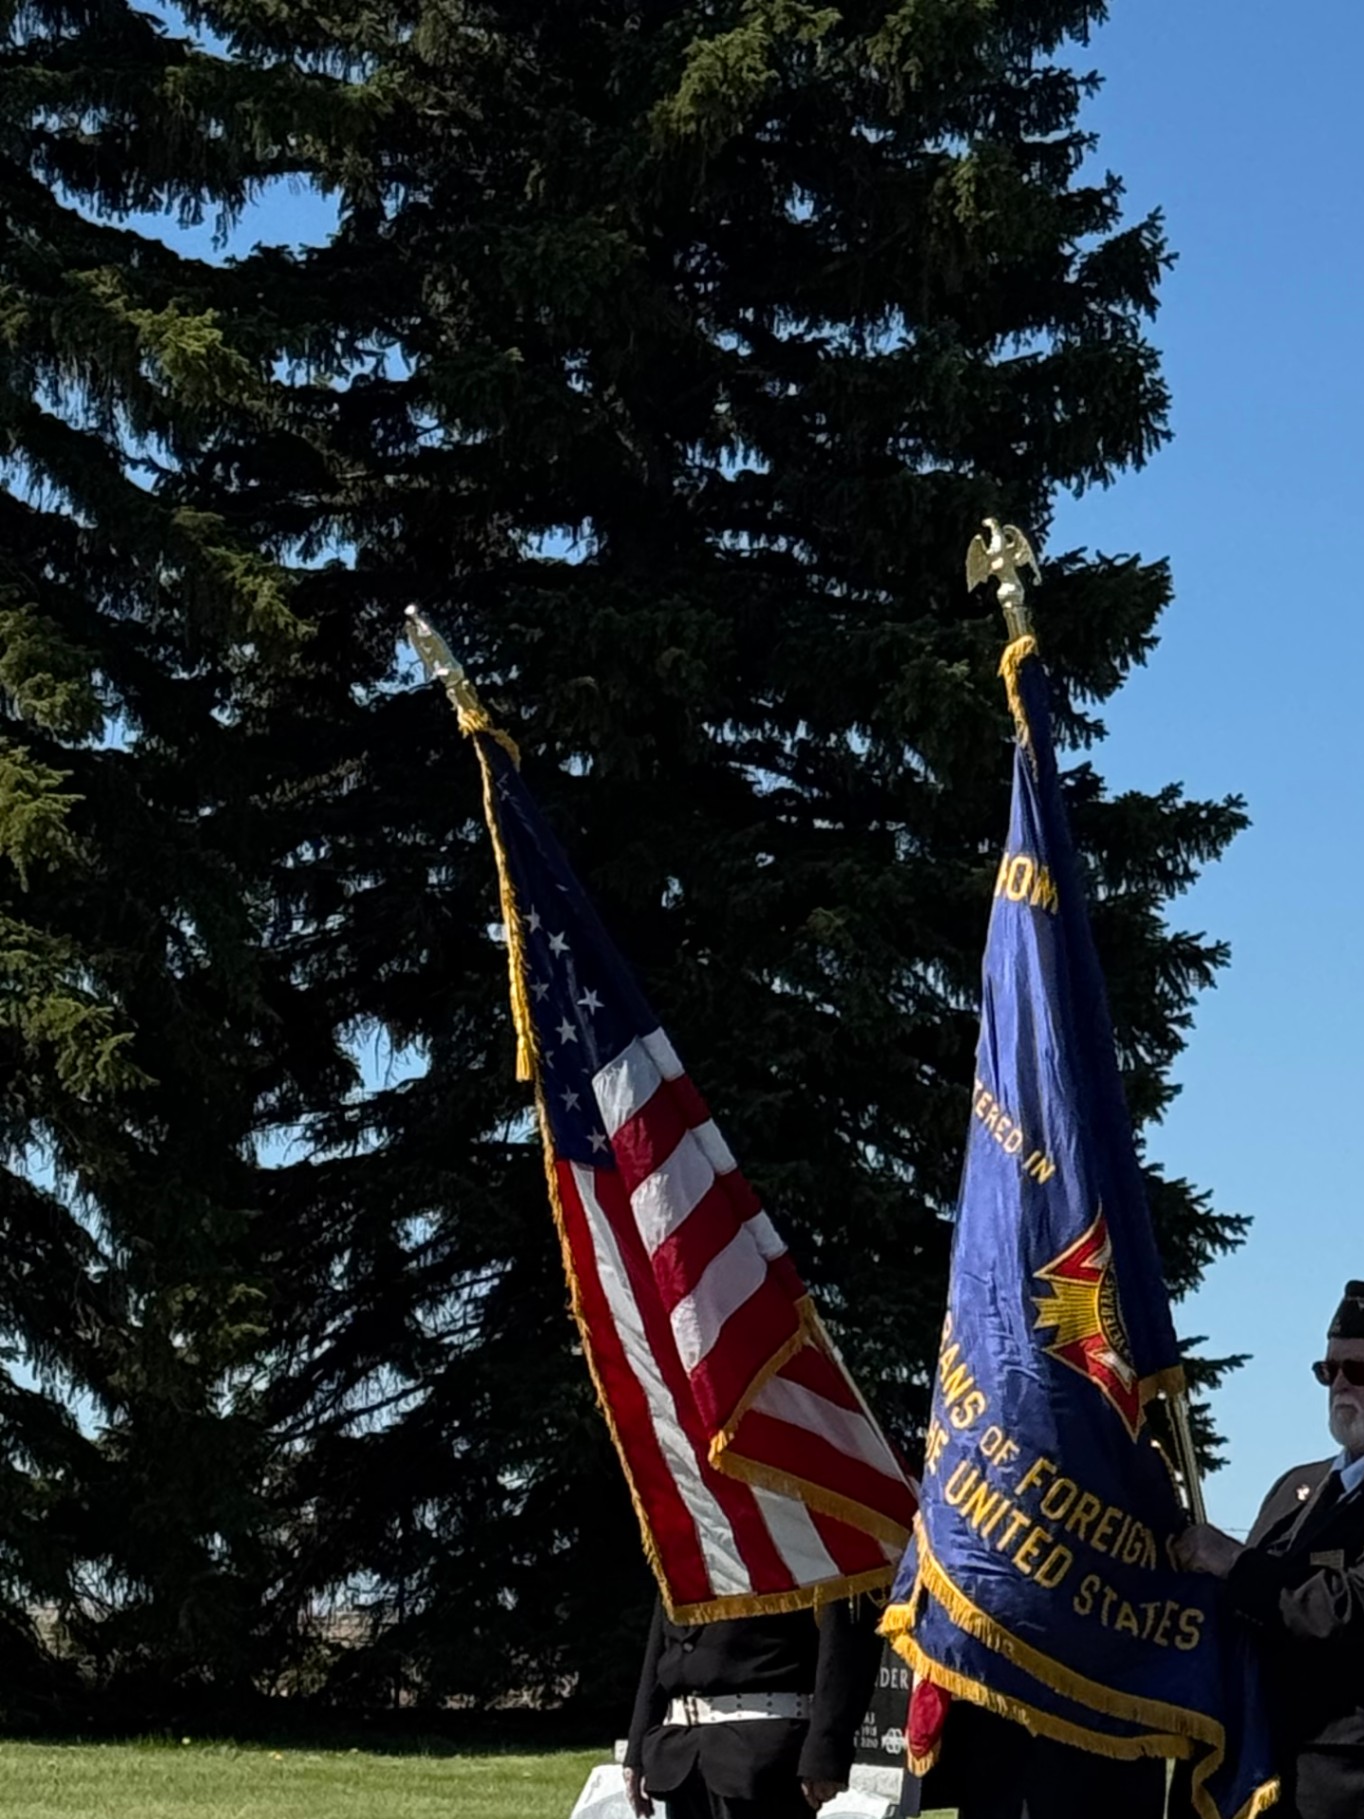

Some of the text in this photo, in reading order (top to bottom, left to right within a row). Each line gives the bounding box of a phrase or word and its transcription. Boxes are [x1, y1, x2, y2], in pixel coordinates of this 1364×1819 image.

[1021, 1150, 1055, 1184] IN
[945, 1460, 1073, 1588] UNITED
[1074, 1574, 1204, 1650] STATES
[980, 1426, 1020, 1466] OF
[1015, 1456, 1157, 1571] FOREIGN
